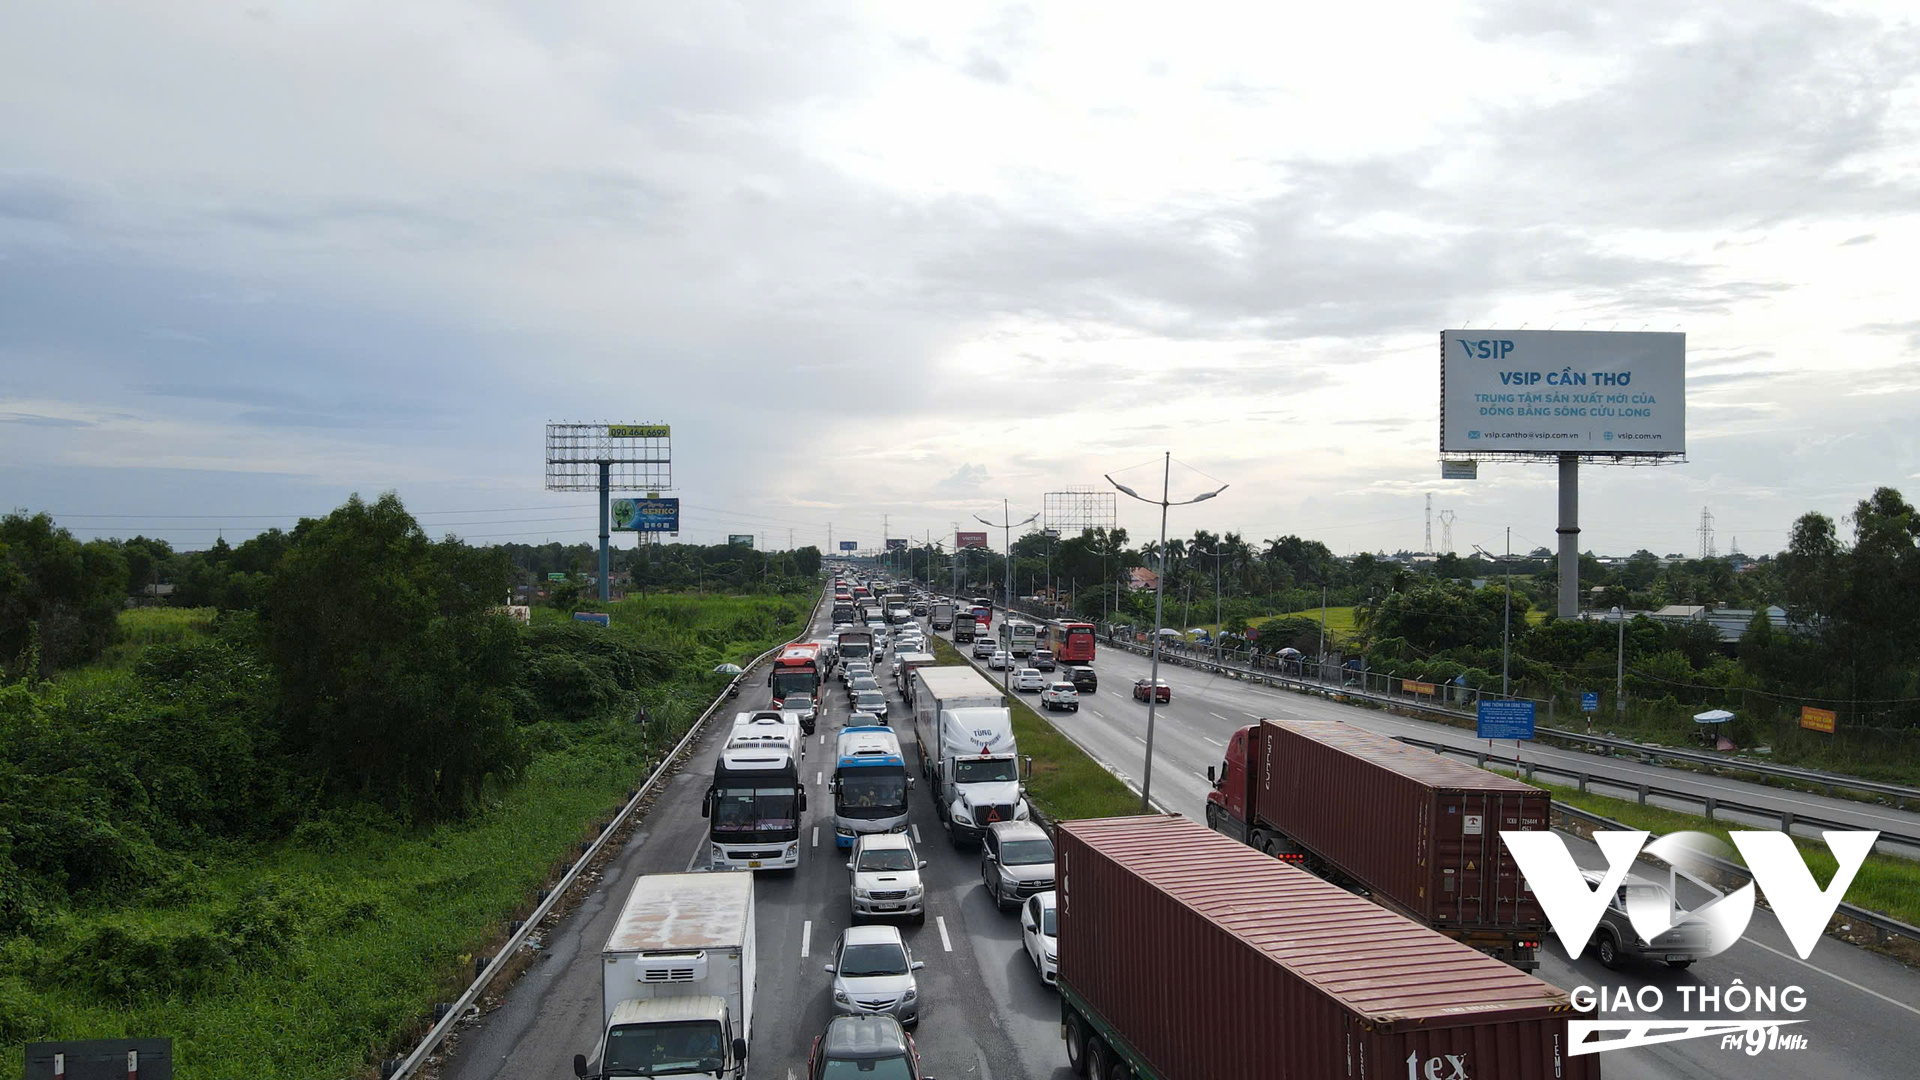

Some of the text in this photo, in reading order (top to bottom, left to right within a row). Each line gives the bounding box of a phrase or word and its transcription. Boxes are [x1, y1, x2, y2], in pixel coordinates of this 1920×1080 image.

[1456, 339, 1515, 359] VSIP
[1500, 366, 1632, 387] VSIP CẦN THƠ
[1474, 391, 1656, 404] TRUNG TÂM SẢN XUẤT MỚI CỦA
[1554, 405, 1587, 417] SÔNG
[1618, 408, 1651, 417] LONG
[611, 428, 667, 437] 090 464 6699
[1484, 431, 1579, 440] vsip.cantho@vsip.com.vn
[1617, 432, 1662, 440] vsip.com.vn
[973, 728, 992, 737] TÙNG
[1553, 1034, 1561, 1079] TEMU
[1406, 1049, 1471, 1080] tex
